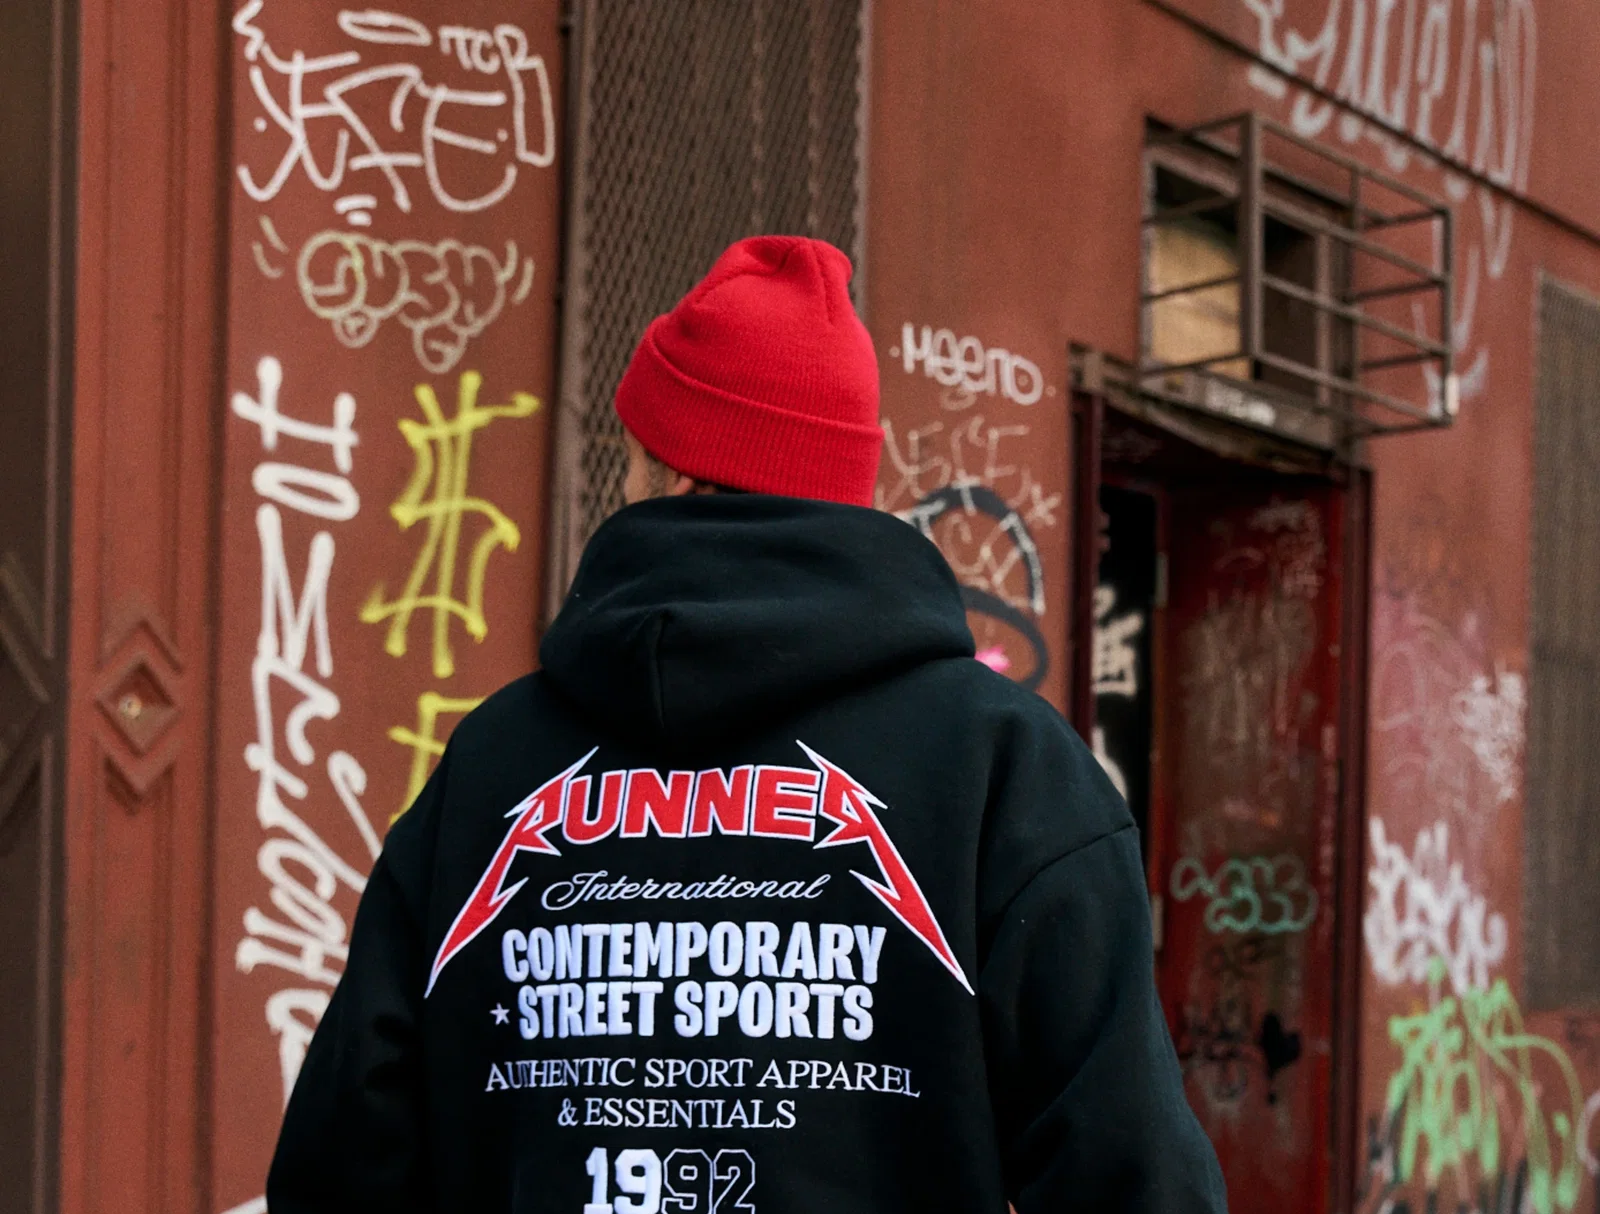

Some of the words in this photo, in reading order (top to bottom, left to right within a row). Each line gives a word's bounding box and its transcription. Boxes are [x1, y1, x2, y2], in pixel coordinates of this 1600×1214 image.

[424, 739, 976, 999] RUNNER
[541, 870, 831, 911] International
[501, 921, 888, 983] CONTEMPORARY
[518, 981, 664, 1041] STREET
[673, 980, 875, 1042] SPORTS
[484, 1057, 636, 1093] AUTHENTIC
[644, 1058, 754, 1090] SPORT
[757, 1059, 921, 1098] APPAREL
[556, 1100, 580, 1128] &
[581, 1098, 798, 1130] ESSENTIALS
